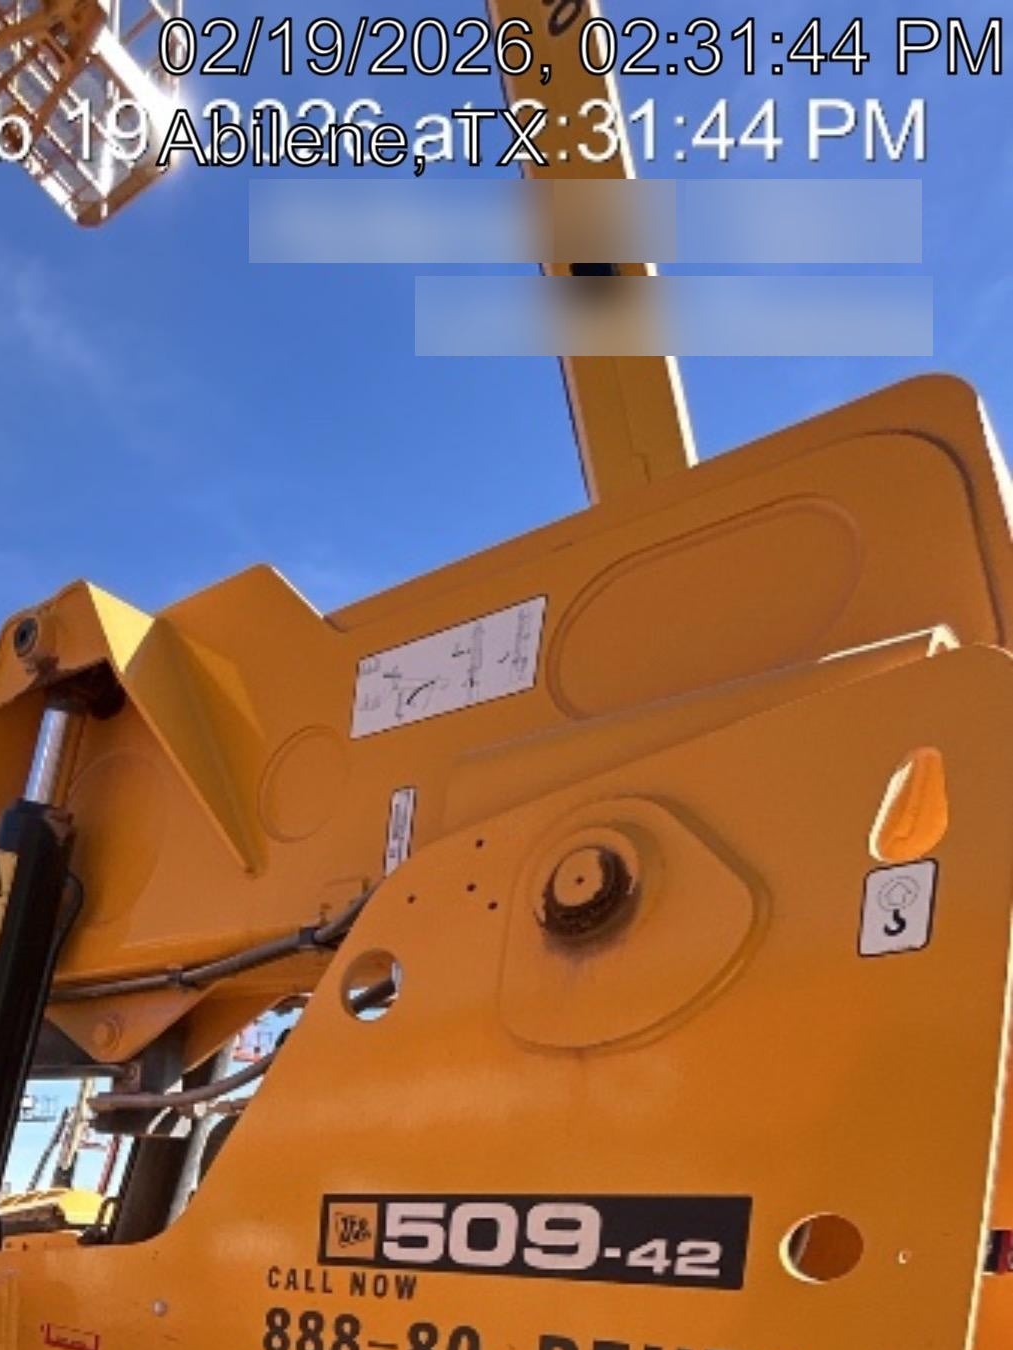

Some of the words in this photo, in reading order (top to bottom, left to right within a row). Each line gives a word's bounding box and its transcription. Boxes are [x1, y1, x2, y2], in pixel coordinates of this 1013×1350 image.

[382, 1202, 723, 1277] 509-42
[267, 1266, 333, 1293] CALL
[349, 1271, 418, 1300] NOW
